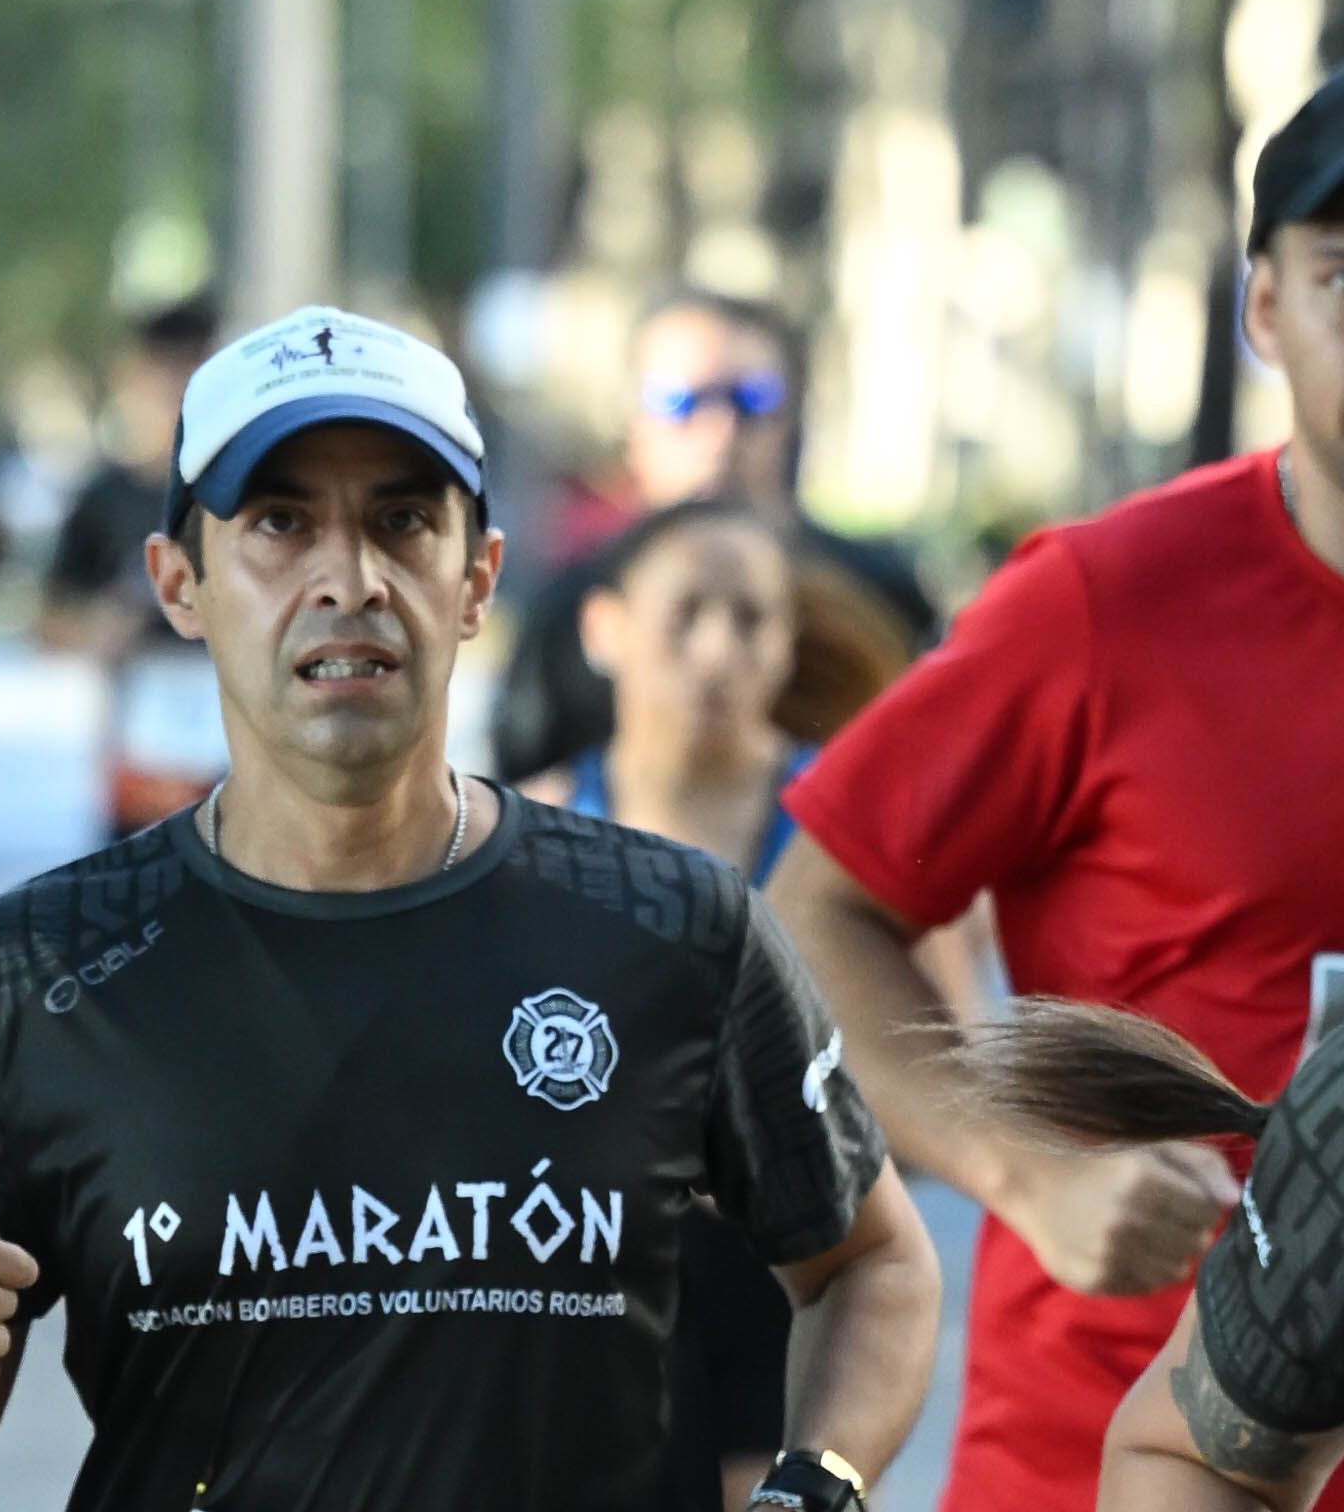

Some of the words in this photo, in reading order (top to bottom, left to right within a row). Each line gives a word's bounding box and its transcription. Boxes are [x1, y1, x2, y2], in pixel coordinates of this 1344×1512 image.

[543, 1025, 584, 1063] 27
[218, 1156, 624, 1277] MARATÓN
[238, 1291, 374, 1323] BOMBEROS
[378, 1288, 545, 1315] VOLUNTARIOS
